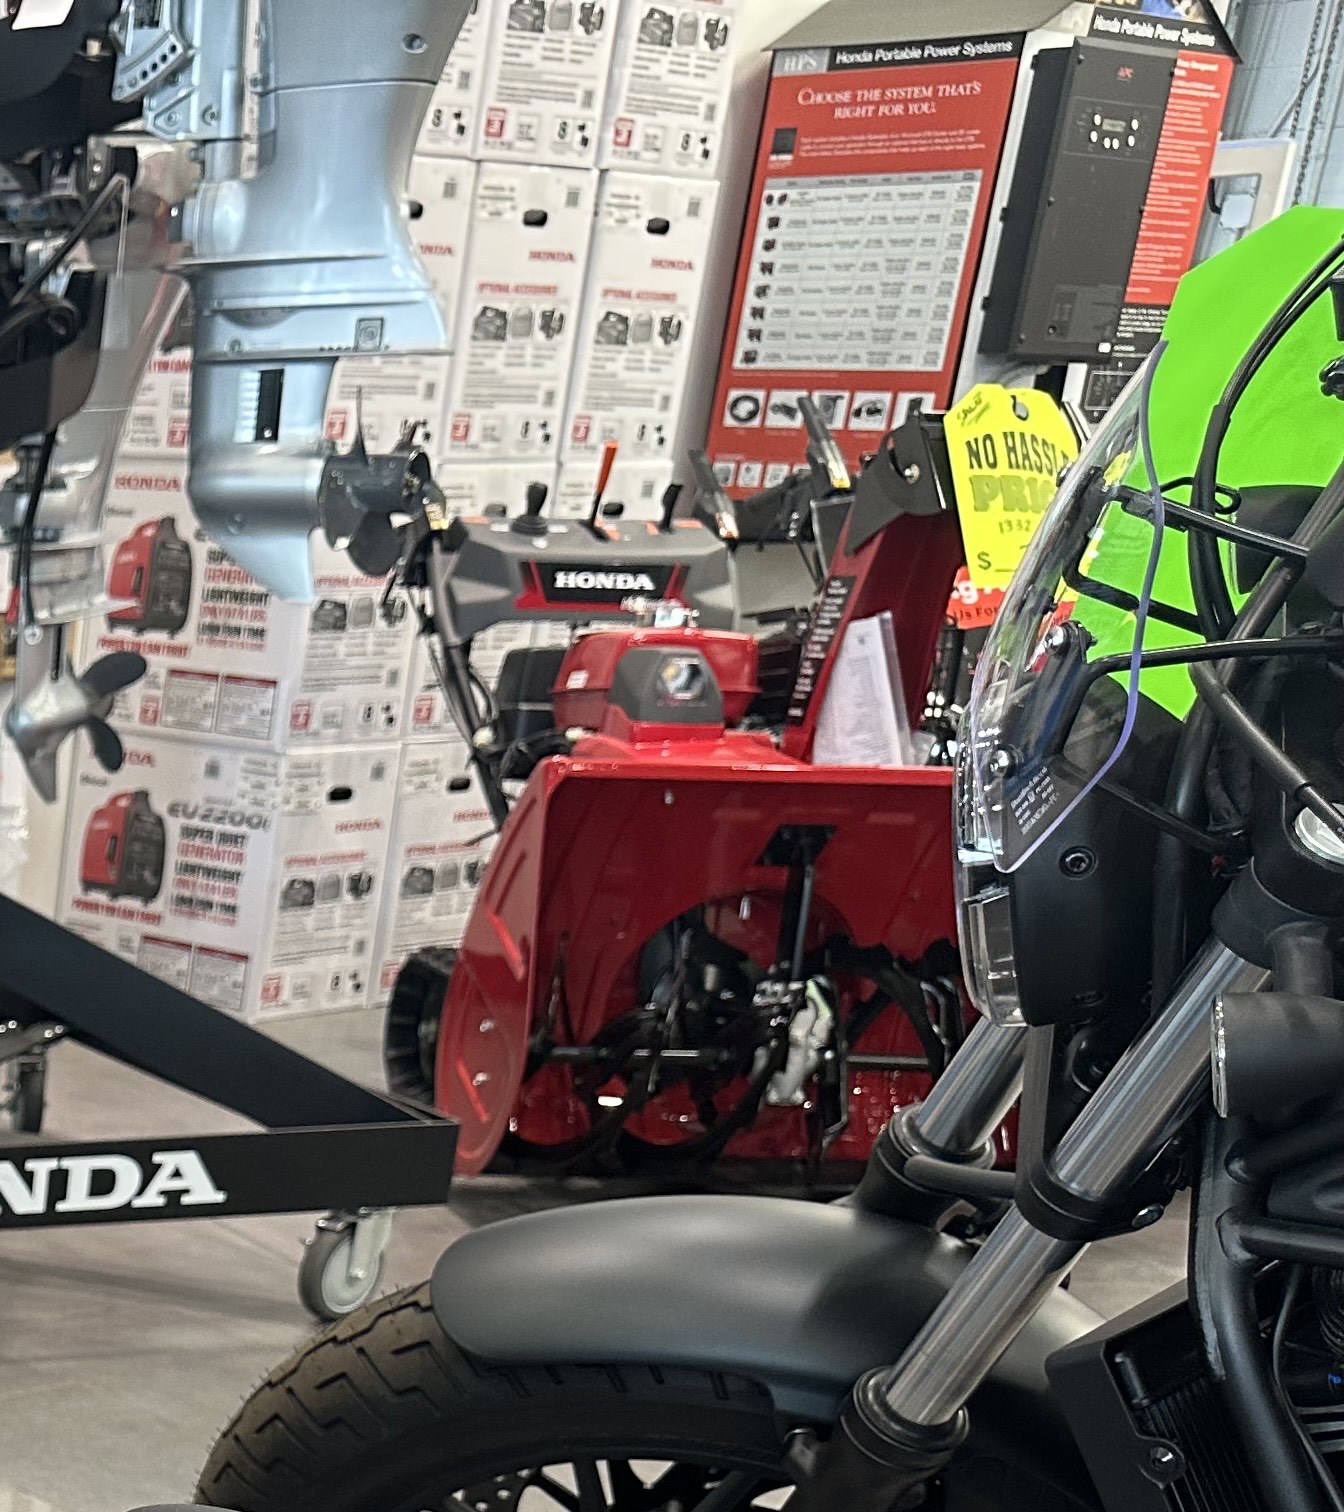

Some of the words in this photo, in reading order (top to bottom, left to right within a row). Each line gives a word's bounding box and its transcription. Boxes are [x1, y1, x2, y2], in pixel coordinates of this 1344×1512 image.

[836, 52, 873, 64] Honda
[874, 47, 922, 62] Portable
[924, 44, 960, 58] Power
[962, 40, 1013, 57] Systems
[785, 54, 818, 72] HPS
[856, 88, 881, 102] THE
[883, 85, 934, 100] SYSTEM
[834, 105, 876, 119] RIGHT
[878, 104, 904, 117] FOR
[966, 433, 997, 469] NO
[115, 476, 181, 492] HONDA
[969, 475, 1055, 514] PRI
[555, 571, 656, 590] HONDA
